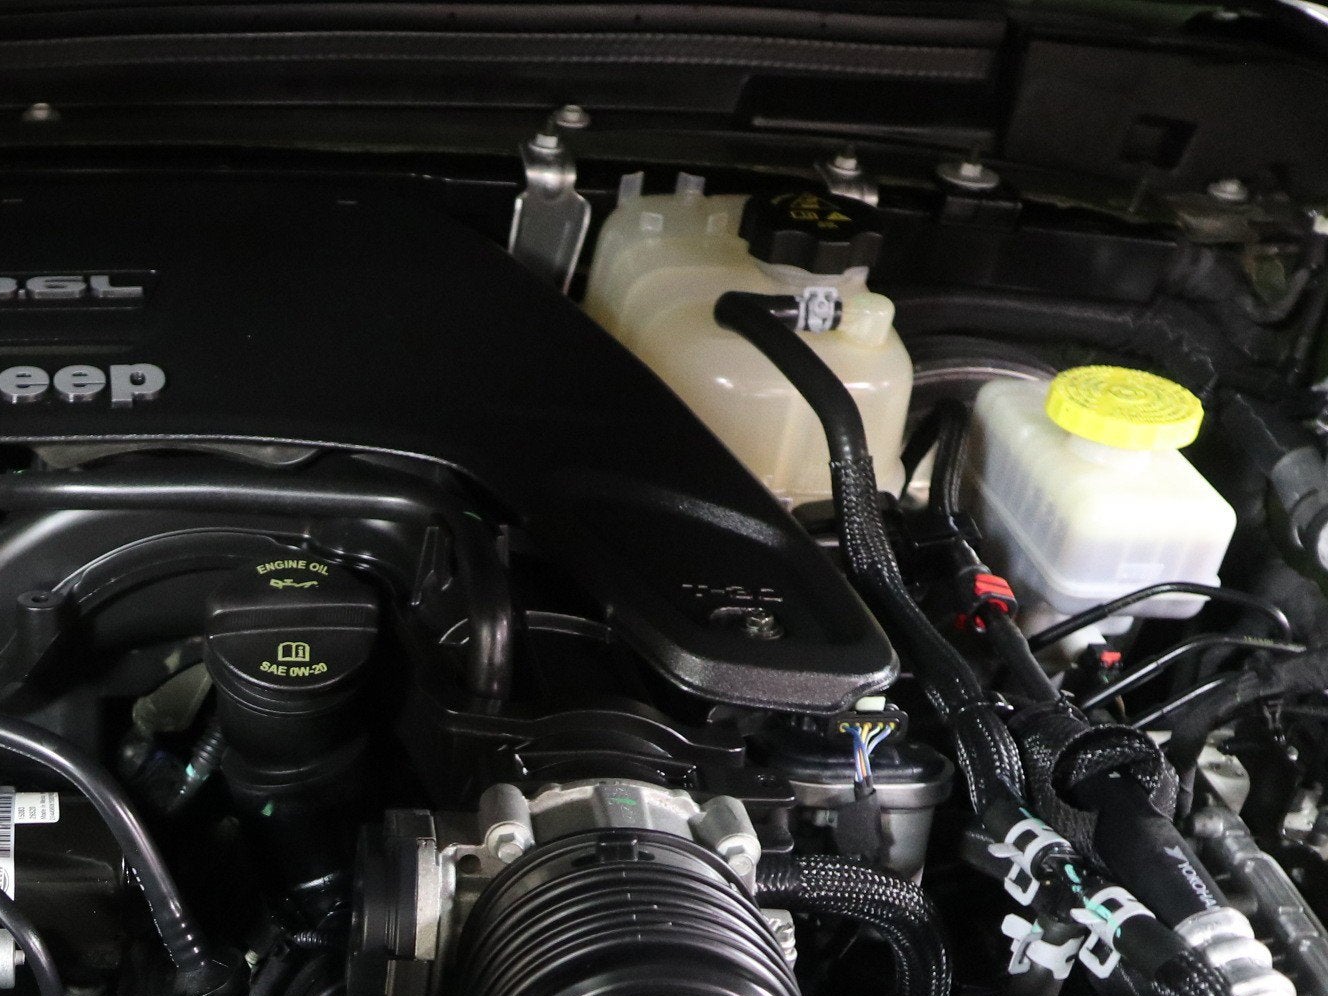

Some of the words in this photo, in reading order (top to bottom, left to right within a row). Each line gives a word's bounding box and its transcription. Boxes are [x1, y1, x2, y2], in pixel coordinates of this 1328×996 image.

[256, 560, 307, 576] ENGINE
[309, 561, 329, 576] OIL
[260, 661, 287, 677] SAE
[289, 662, 328, 677] 0W-20
